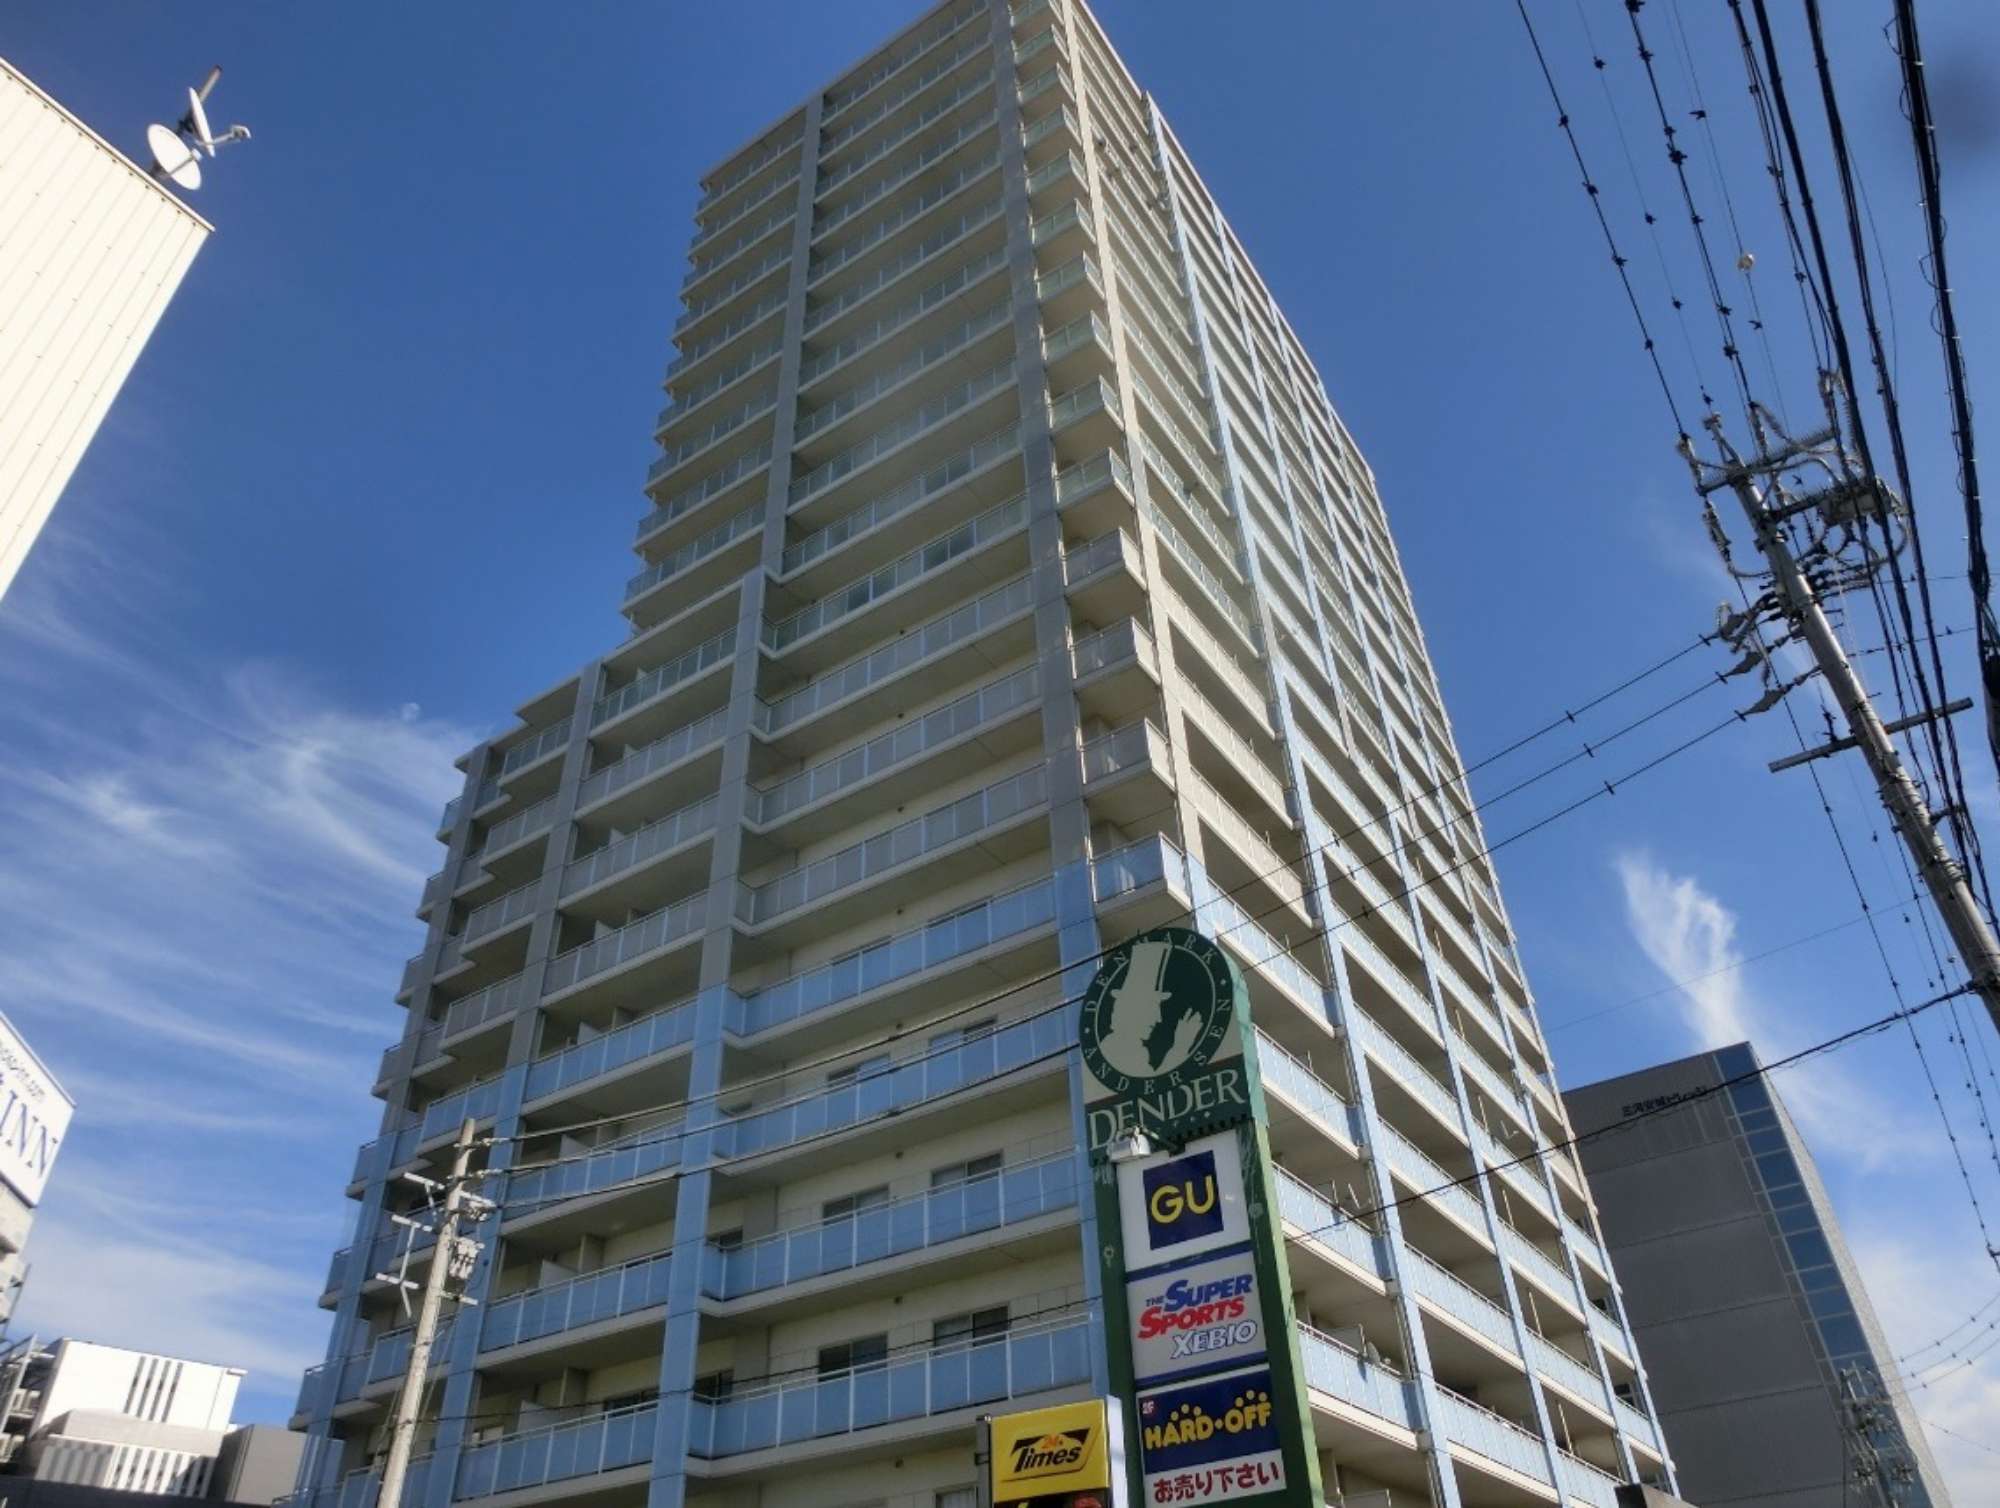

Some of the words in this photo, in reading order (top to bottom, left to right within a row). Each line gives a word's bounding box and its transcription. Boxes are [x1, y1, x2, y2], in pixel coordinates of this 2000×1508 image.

[1088, 1068, 1246, 1149] DENDER
[1151, 1174, 1215, 1224] GU
[1164, 1274, 1254, 1312] SUPER
[1137, 1296, 1246, 1339] SPORTS
[1170, 1319, 1258, 1360] XEBIO
[1011, 1437, 1083, 1474] Times
[1153, 1461, 1280, 1503] お売り下さい
